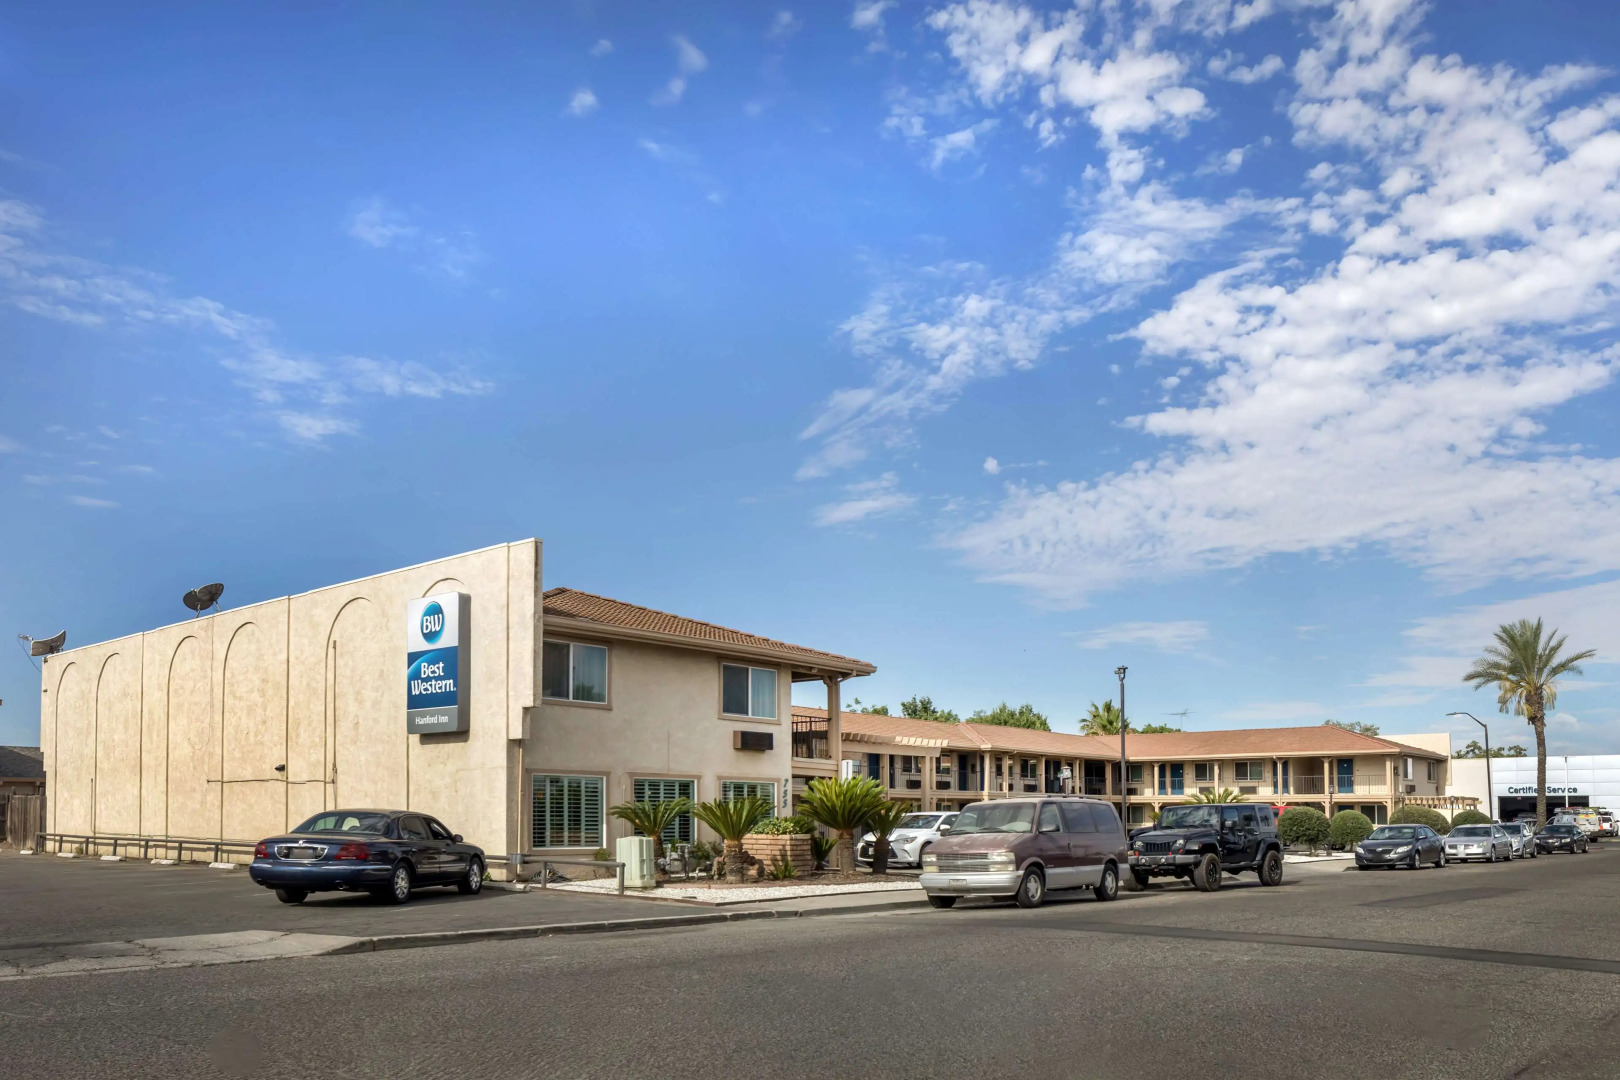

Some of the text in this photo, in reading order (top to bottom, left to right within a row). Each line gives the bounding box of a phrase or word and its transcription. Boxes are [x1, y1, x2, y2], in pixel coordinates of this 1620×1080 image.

[422, 613, 443, 634] BW
[420, 661, 445, 678] Best
[415, 714, 449, 725] Hanford Inn
[1508, 786, 1578, 794] Certifie Servce
